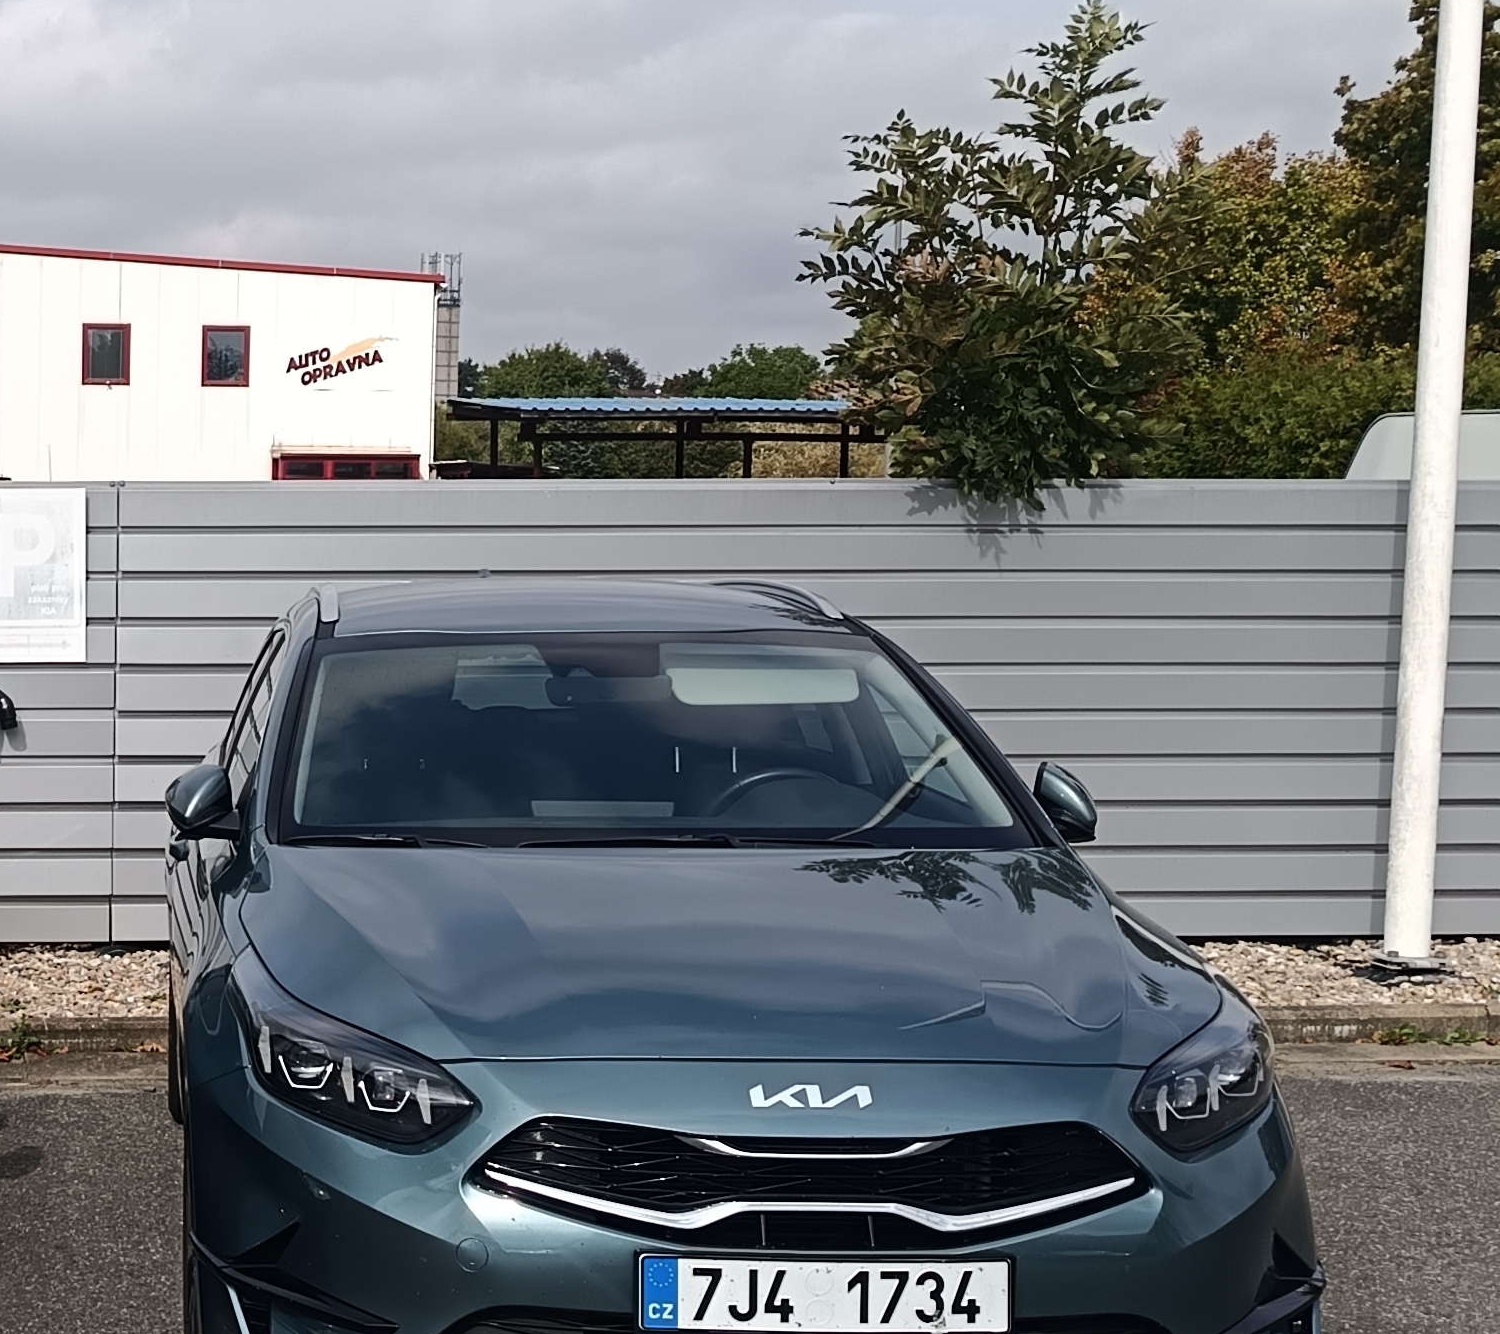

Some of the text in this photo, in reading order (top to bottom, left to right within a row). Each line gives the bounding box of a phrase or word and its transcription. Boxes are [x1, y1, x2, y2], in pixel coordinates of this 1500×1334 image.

[285, 347, 331, 373] AUTO
[300, 350, 384, 386] OPRAVNA
[692, 1267, 981, 1324] 7J4 1734
[648, 1303, 674, 1320] CZ
